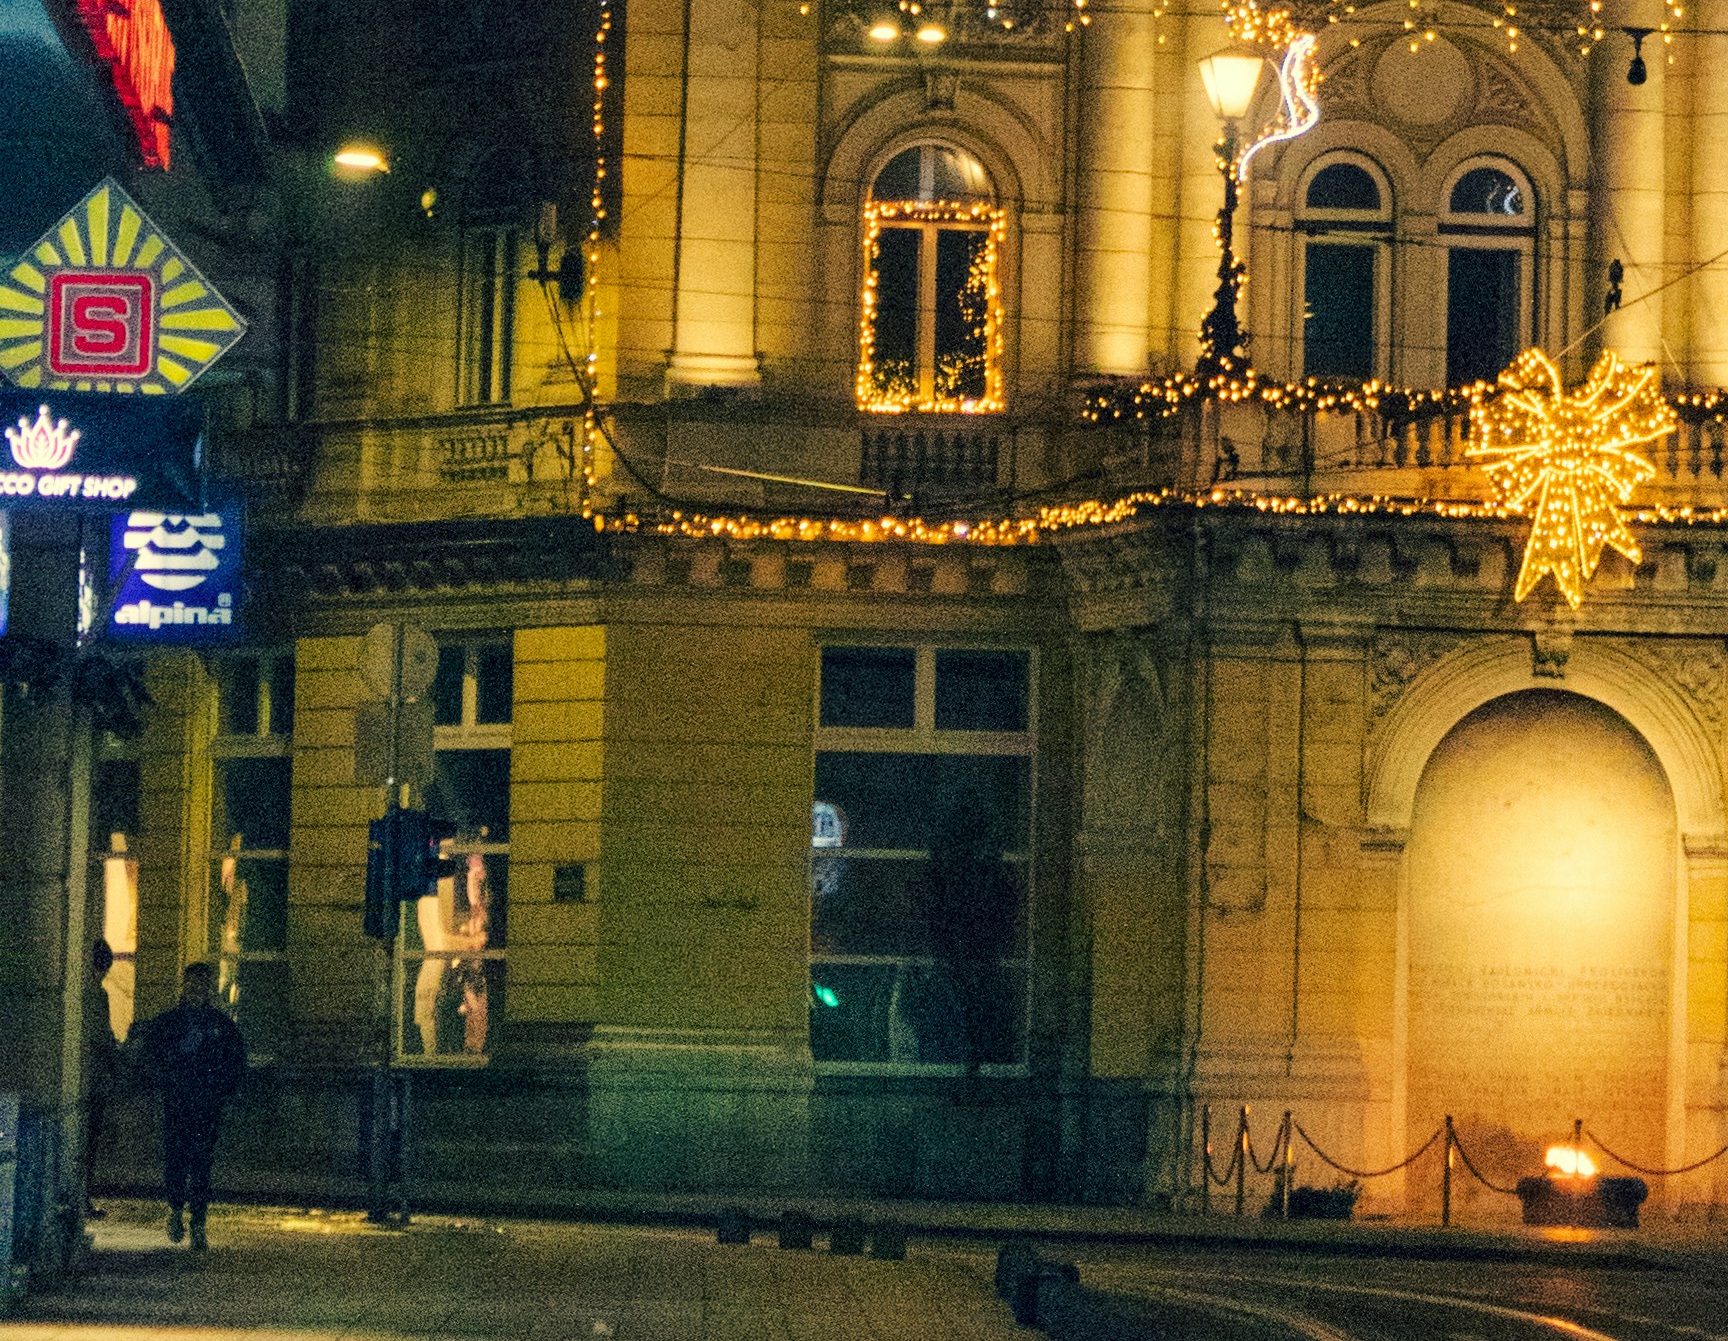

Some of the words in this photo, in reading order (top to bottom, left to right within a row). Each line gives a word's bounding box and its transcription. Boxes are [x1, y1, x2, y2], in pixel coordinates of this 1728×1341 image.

[38, 474, 82, 498] GIFT
[82, 475, 137, 499] SHOP
[114, 599, 232, 629] alpina
